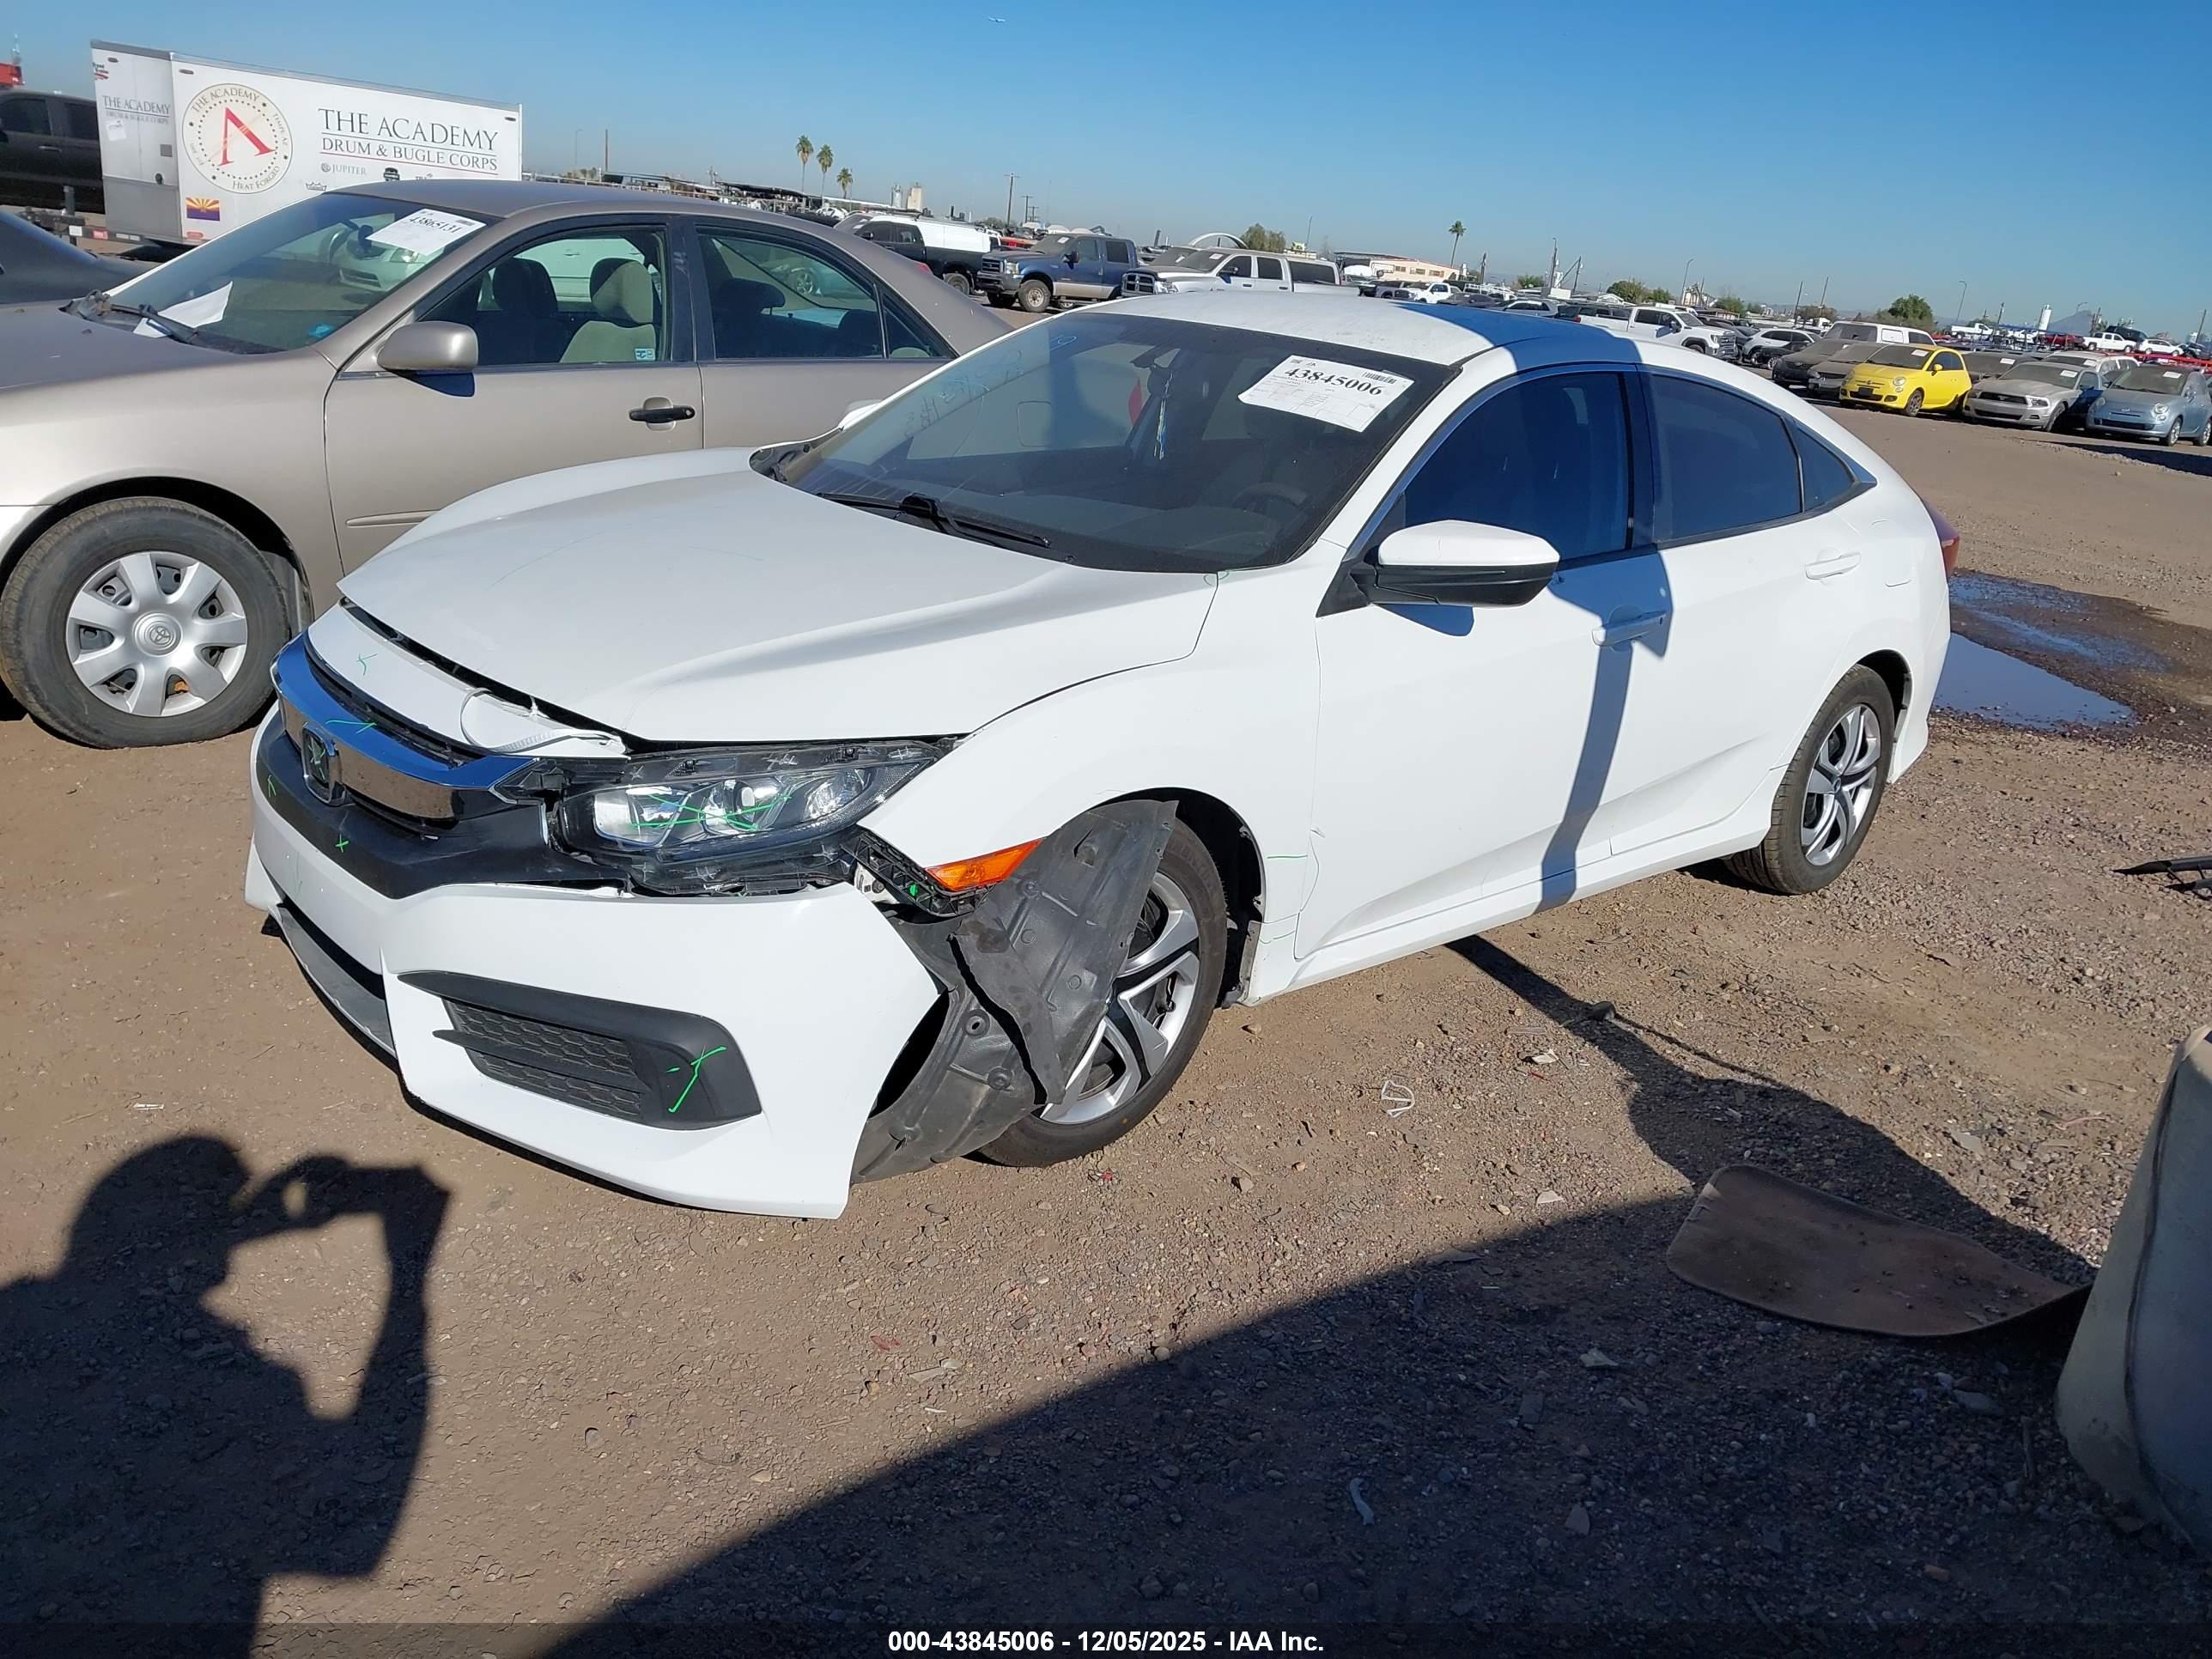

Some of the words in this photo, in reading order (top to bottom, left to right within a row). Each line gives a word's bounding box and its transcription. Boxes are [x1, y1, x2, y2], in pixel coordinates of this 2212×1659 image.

[102, 95, 121, 108] THE
[124, 99, 171, 115] ACADEMY
[191, 95, 209, 112] THE
[210, 88, 260, 102] ACADEMY
[318, 108, 369, 135] THE
[377, 116, 498, 151] ACADEMY
[322, 137, 372, 155] DRUM
[376, 144, 387, 157] &
[393, 146, 446, 164] BUGLE
[449, 153, 498, 171] CORPS
[232, 180, 254, 191] HEAT
[255, 166, 280, 189] FORGED
[331, 163, 367, 175] JUPITER
[410, 216, 463, 233] 43865131
[1285, 368, 1388, 395] 43845006
